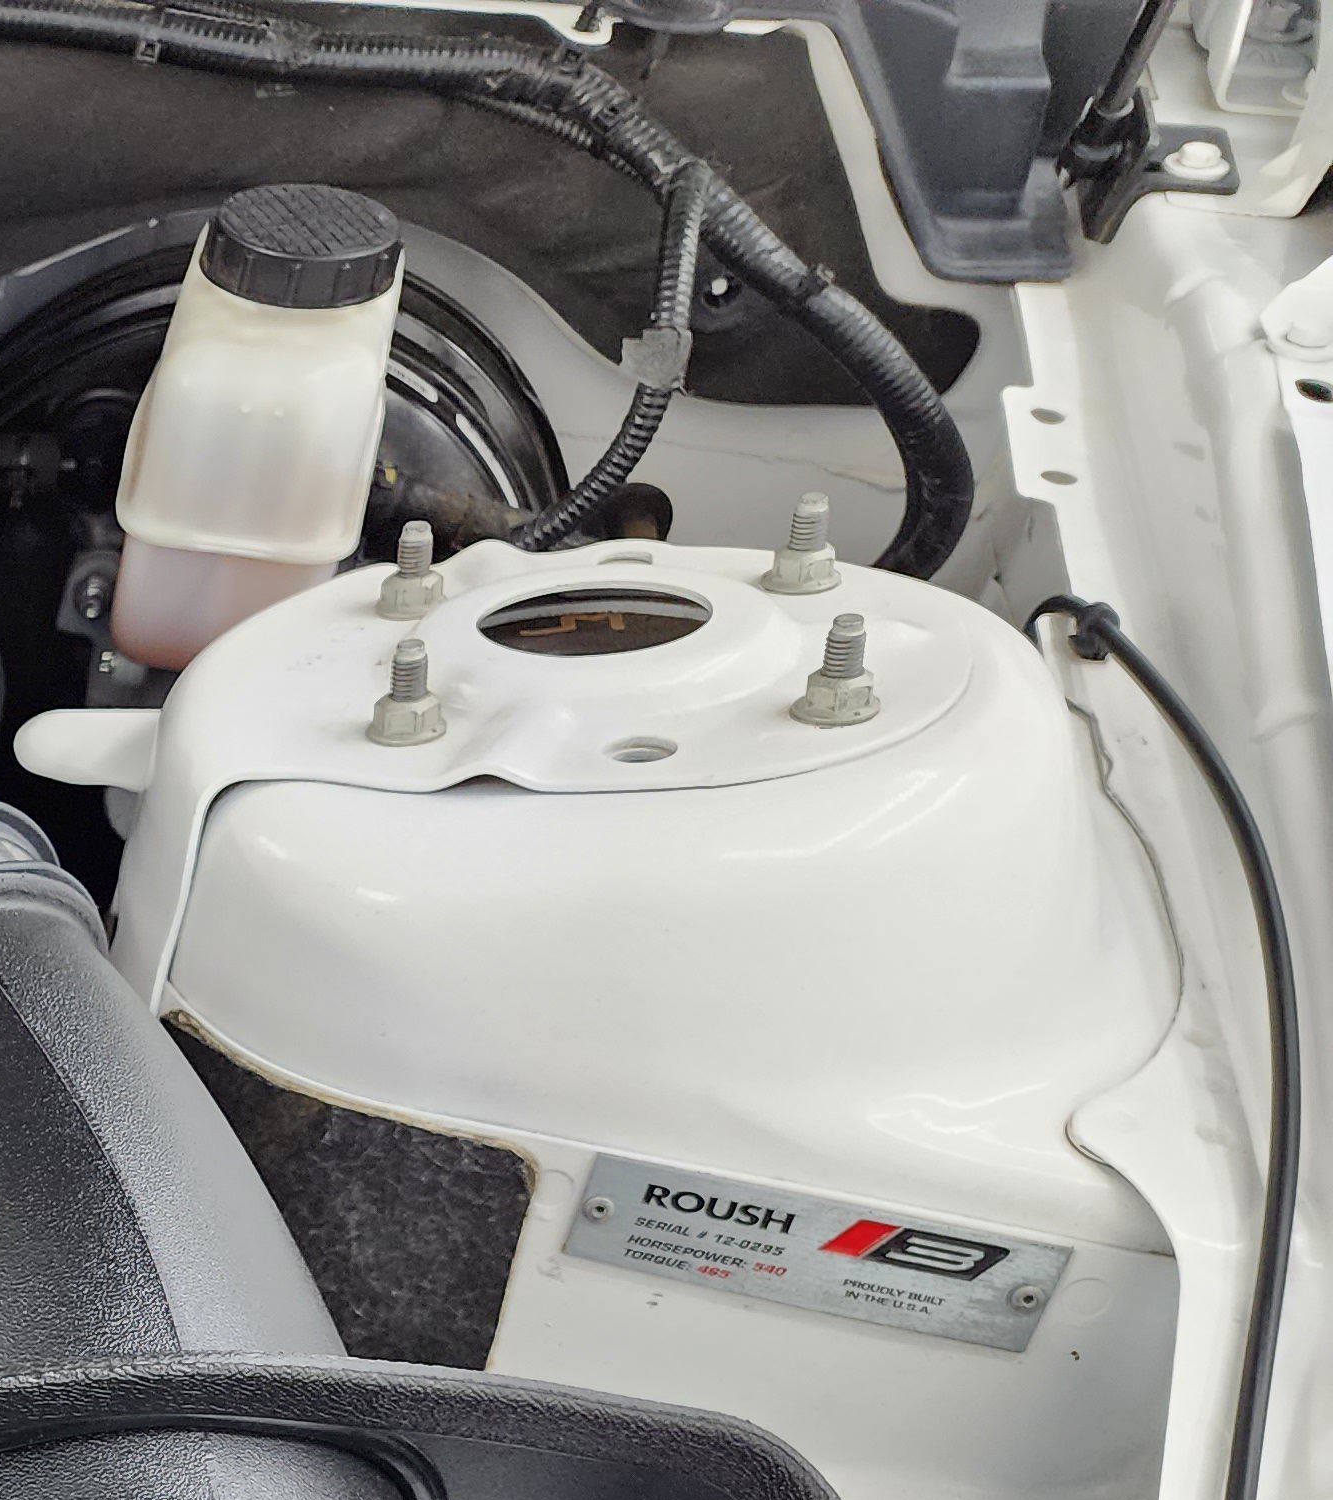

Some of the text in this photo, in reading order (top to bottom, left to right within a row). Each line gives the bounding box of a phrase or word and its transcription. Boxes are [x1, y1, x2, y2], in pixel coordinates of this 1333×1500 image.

[641, 1183, 796, 1234] ROUSH
[634, 1216, 690, 1237] SERIAL
[623, 1248, 732, 1280] TORQUE: 465
[627, 1234, 788, 1278] HORSEPOWER: 540
[842, 1278, 946, 1306] PROUDLY BUILT
[844, 1290, 860, 1300] IN
[864, 1293, 889, 1306] THE
